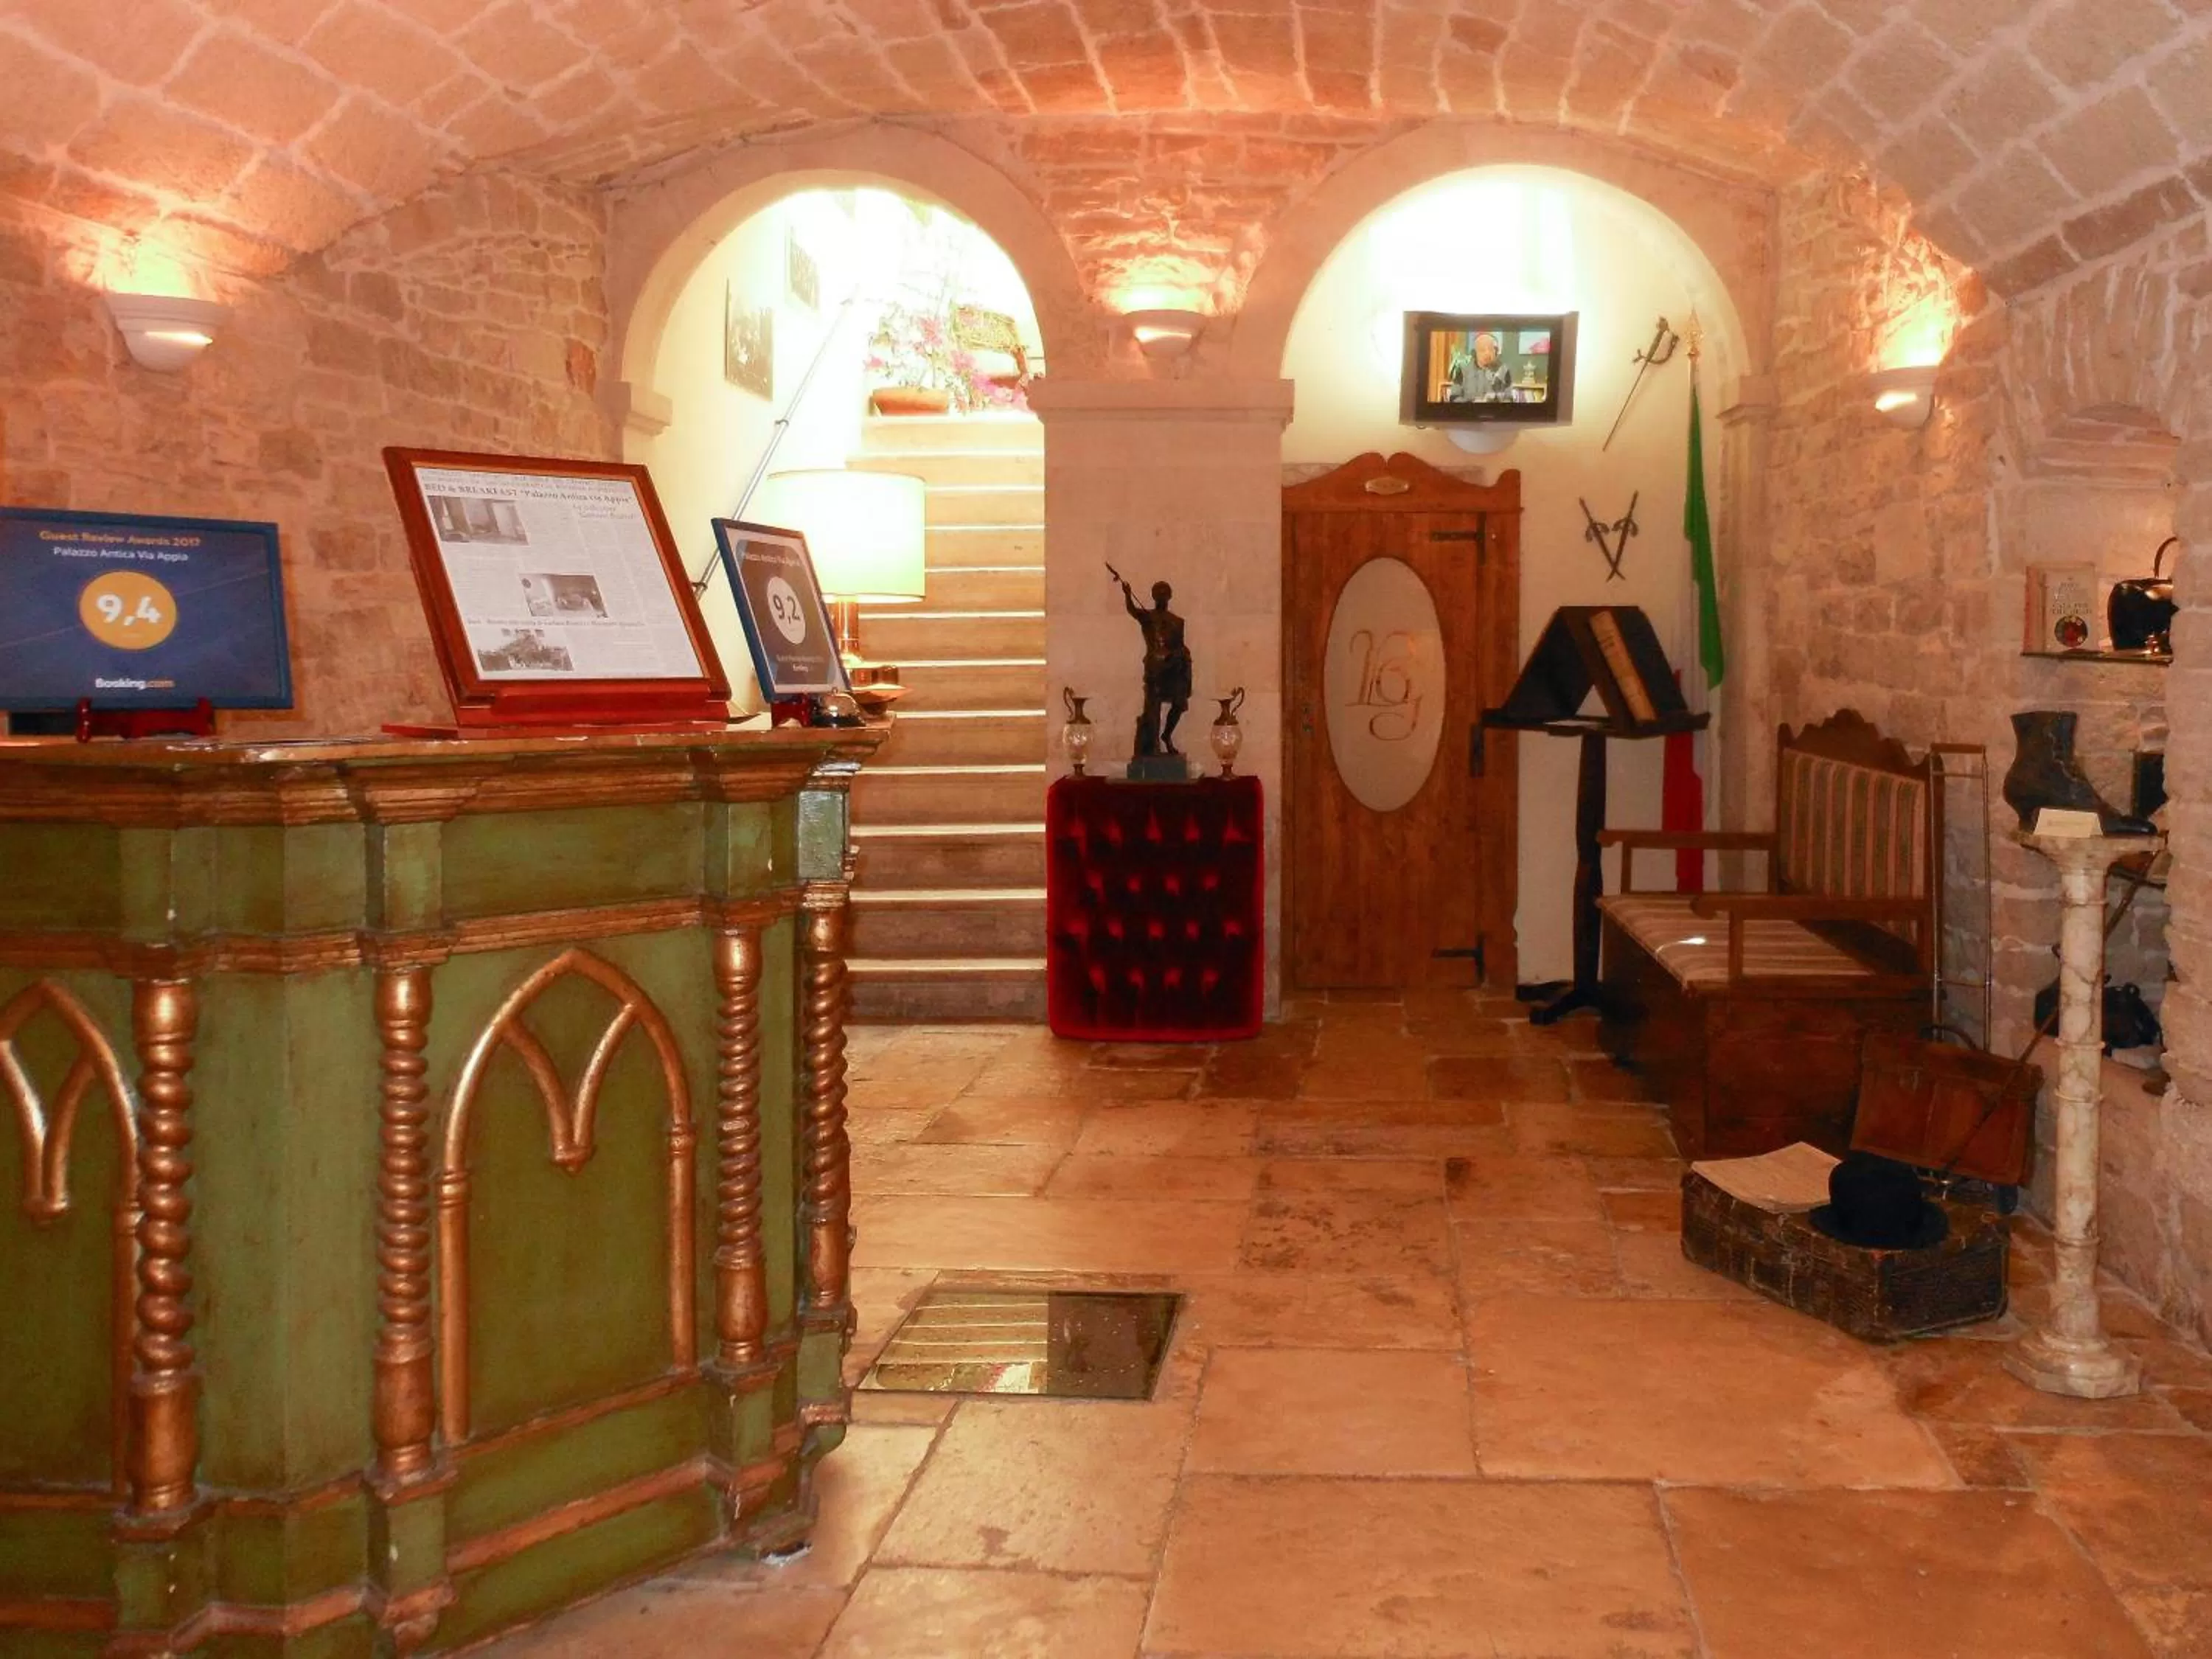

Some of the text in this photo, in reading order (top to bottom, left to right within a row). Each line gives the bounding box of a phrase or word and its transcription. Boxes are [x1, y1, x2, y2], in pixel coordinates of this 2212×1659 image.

[97, 594, 161, 626] 9,4
[772, 594, 801, 624] 9,2
[95, 678, 175, 690] Booking.com
